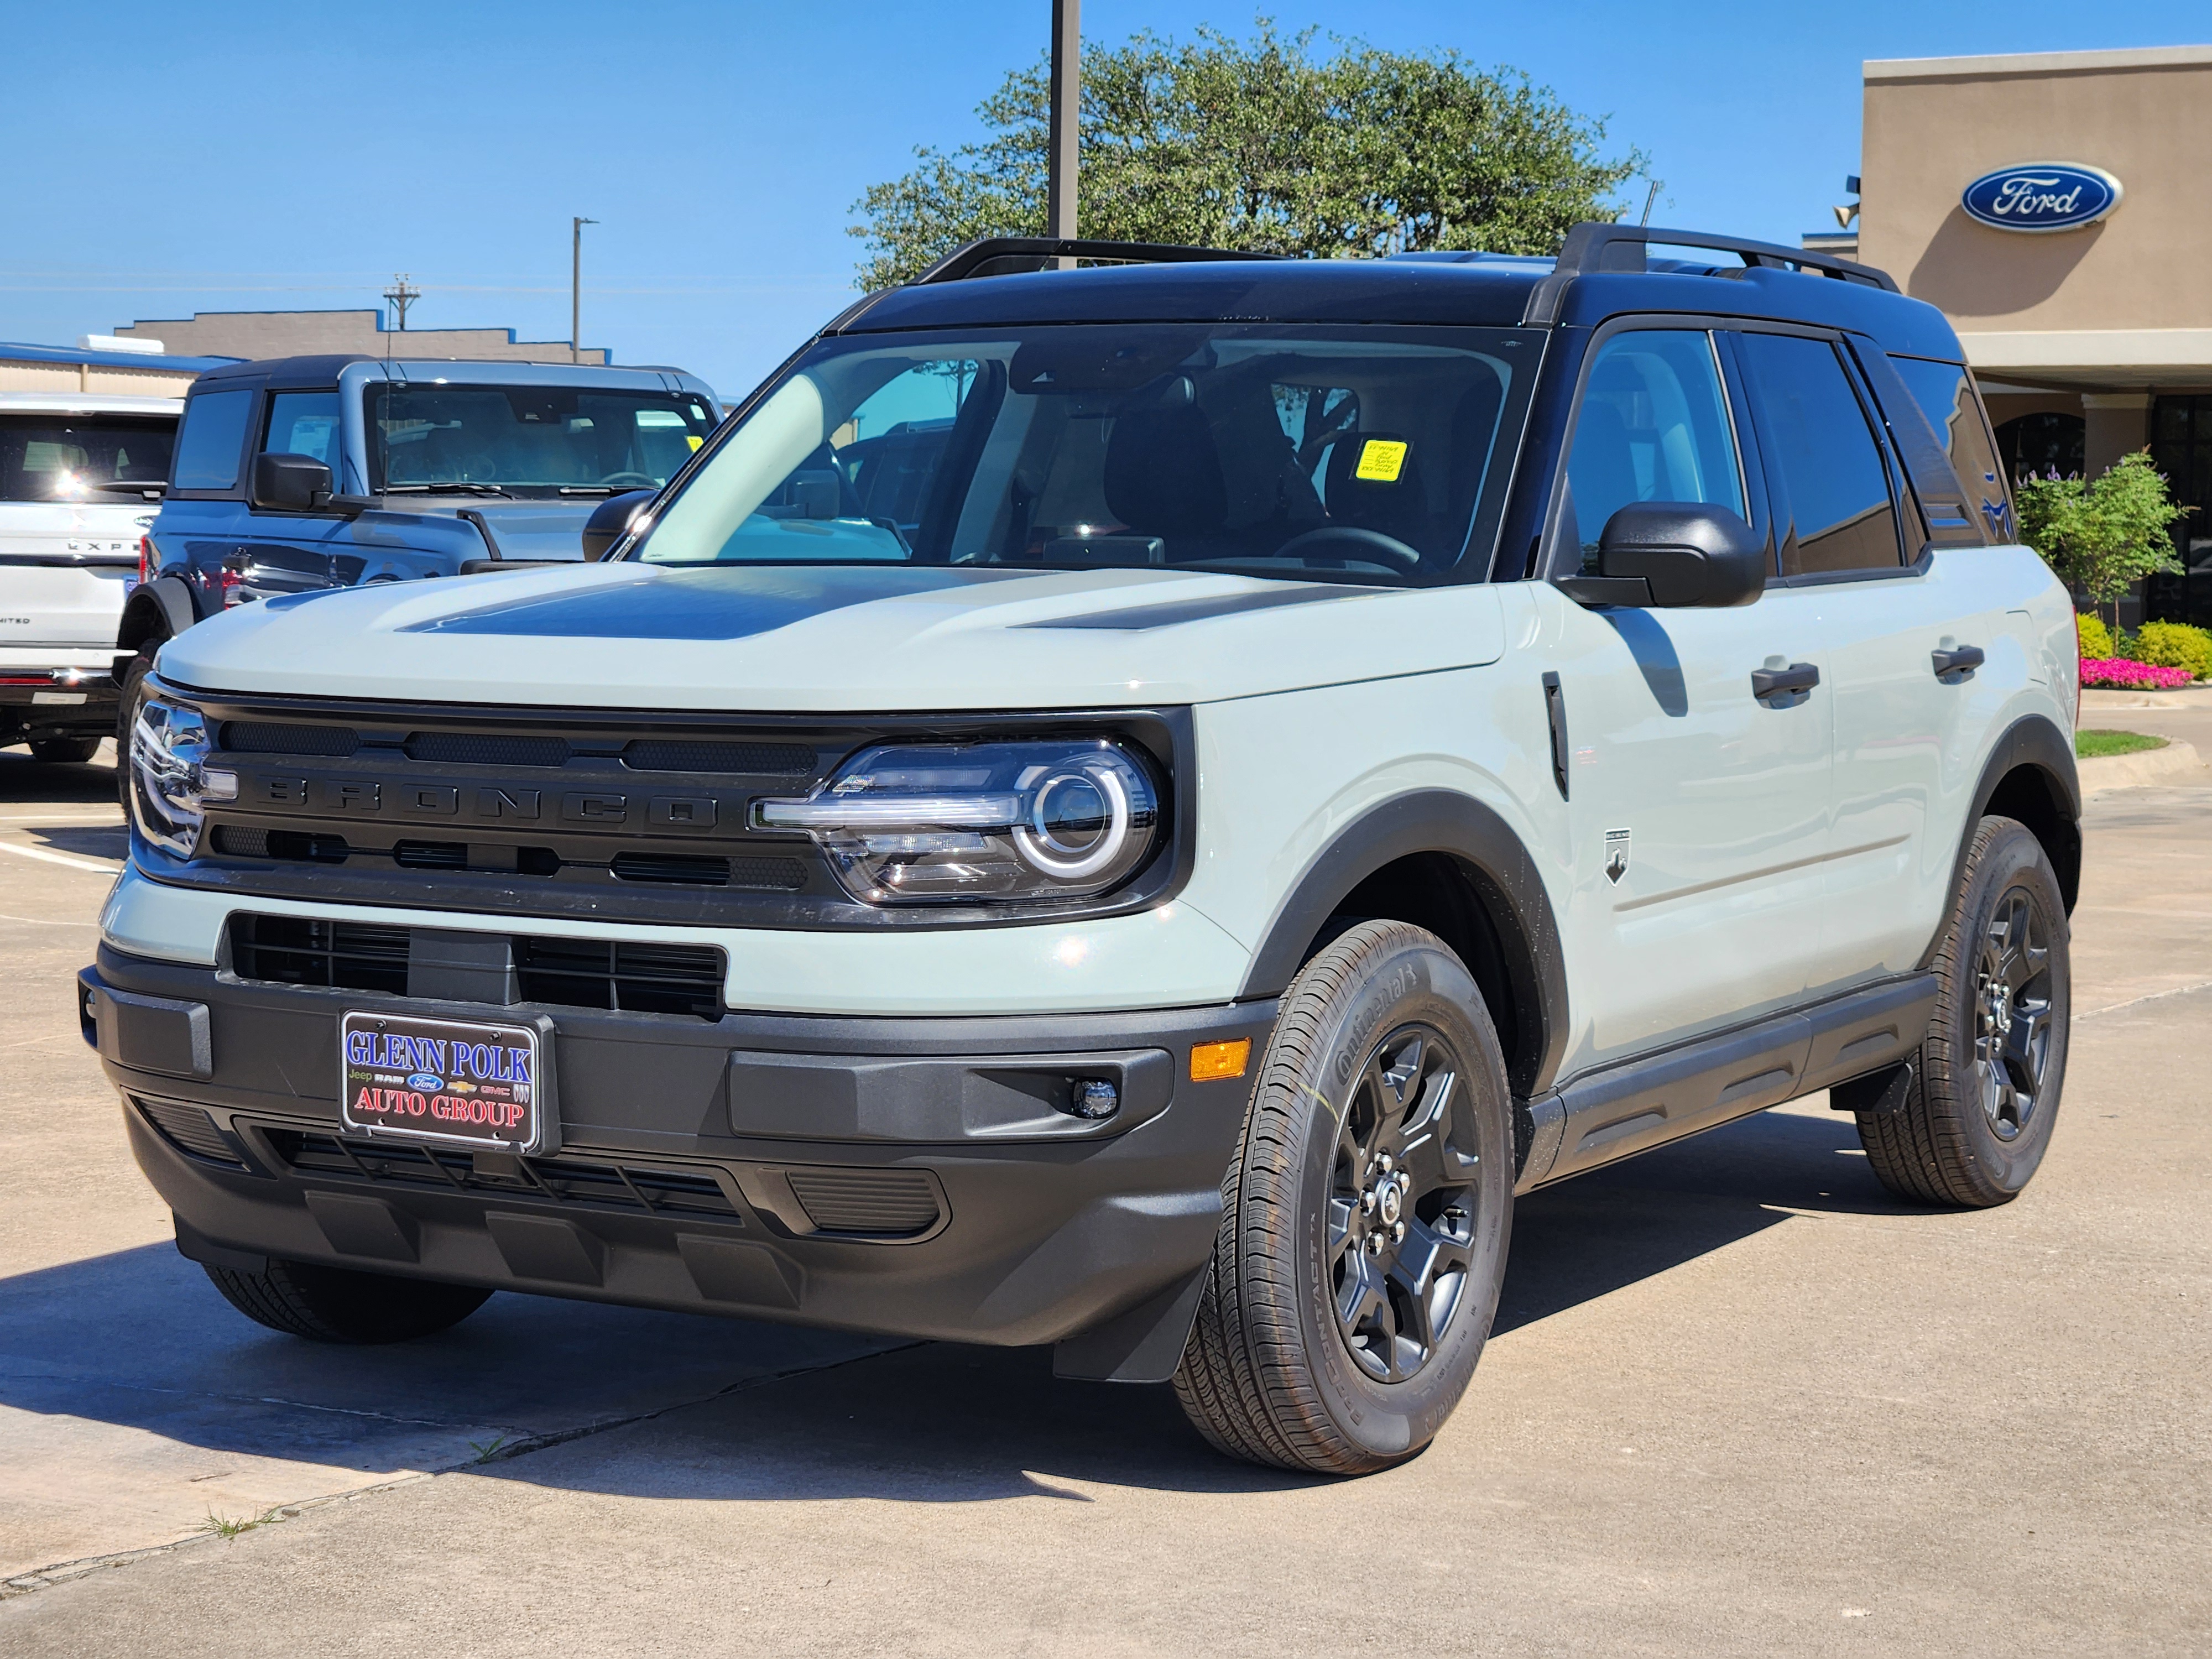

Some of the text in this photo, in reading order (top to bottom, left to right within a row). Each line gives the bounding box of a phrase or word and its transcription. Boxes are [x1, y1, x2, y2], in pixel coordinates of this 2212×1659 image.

[1992, 178, 2083, 215] Ford
[257, 775, 719, 827] BRONCO
[1335, 967, 1406, 1086] Continental
[346, 1030, 532, 1083] GLENN POLK
[348, 1068, 511, 1096] Jeep RAM Ford GMC
[354, 1087, 524, 1128] AUTO GROUP
